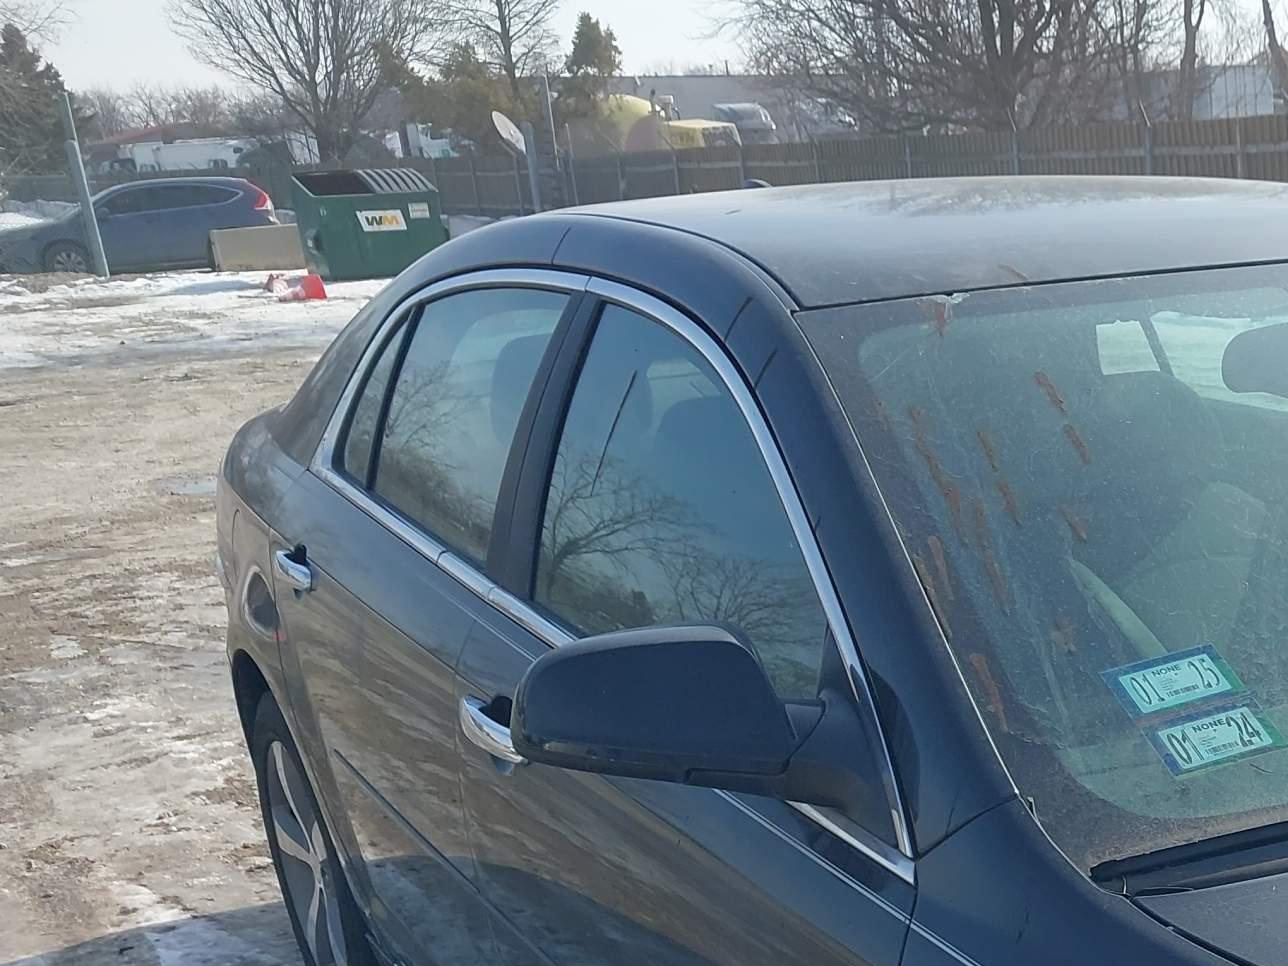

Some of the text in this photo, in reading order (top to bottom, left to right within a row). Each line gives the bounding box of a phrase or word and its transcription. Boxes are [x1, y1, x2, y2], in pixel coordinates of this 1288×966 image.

[364, 215, 401, 226] WM
[1128, 673, 1166, 705] 01
[1151, 664, 1181, 677] NONE
[1187, 658, 1220, 689] 25
[1166, 712, 1264, 765] 01 NONE 24
